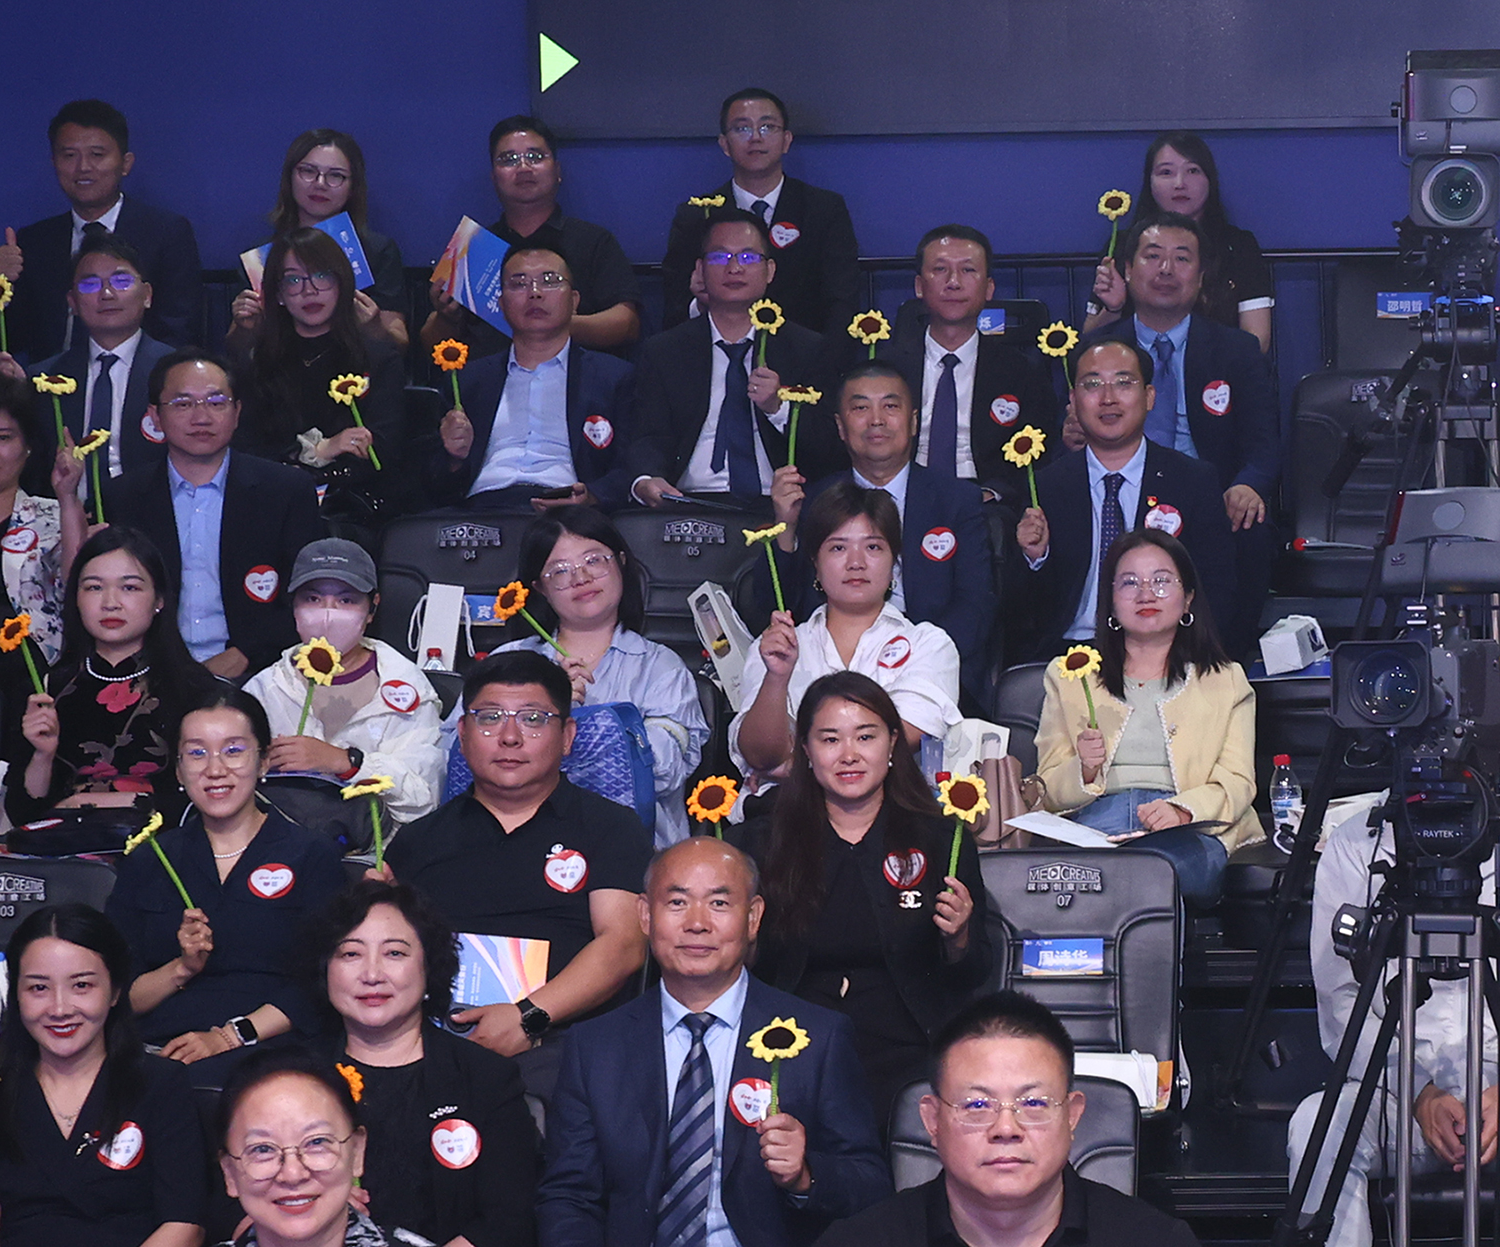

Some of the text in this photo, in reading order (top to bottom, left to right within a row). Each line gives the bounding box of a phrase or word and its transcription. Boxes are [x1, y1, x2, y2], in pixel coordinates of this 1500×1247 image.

[687, 546, 700, 556] 05
[1422, 829, 1454, 839] RAYTEK
[1057, 895, 1072, 907] 07
[0, 905, 15, 917] 03
